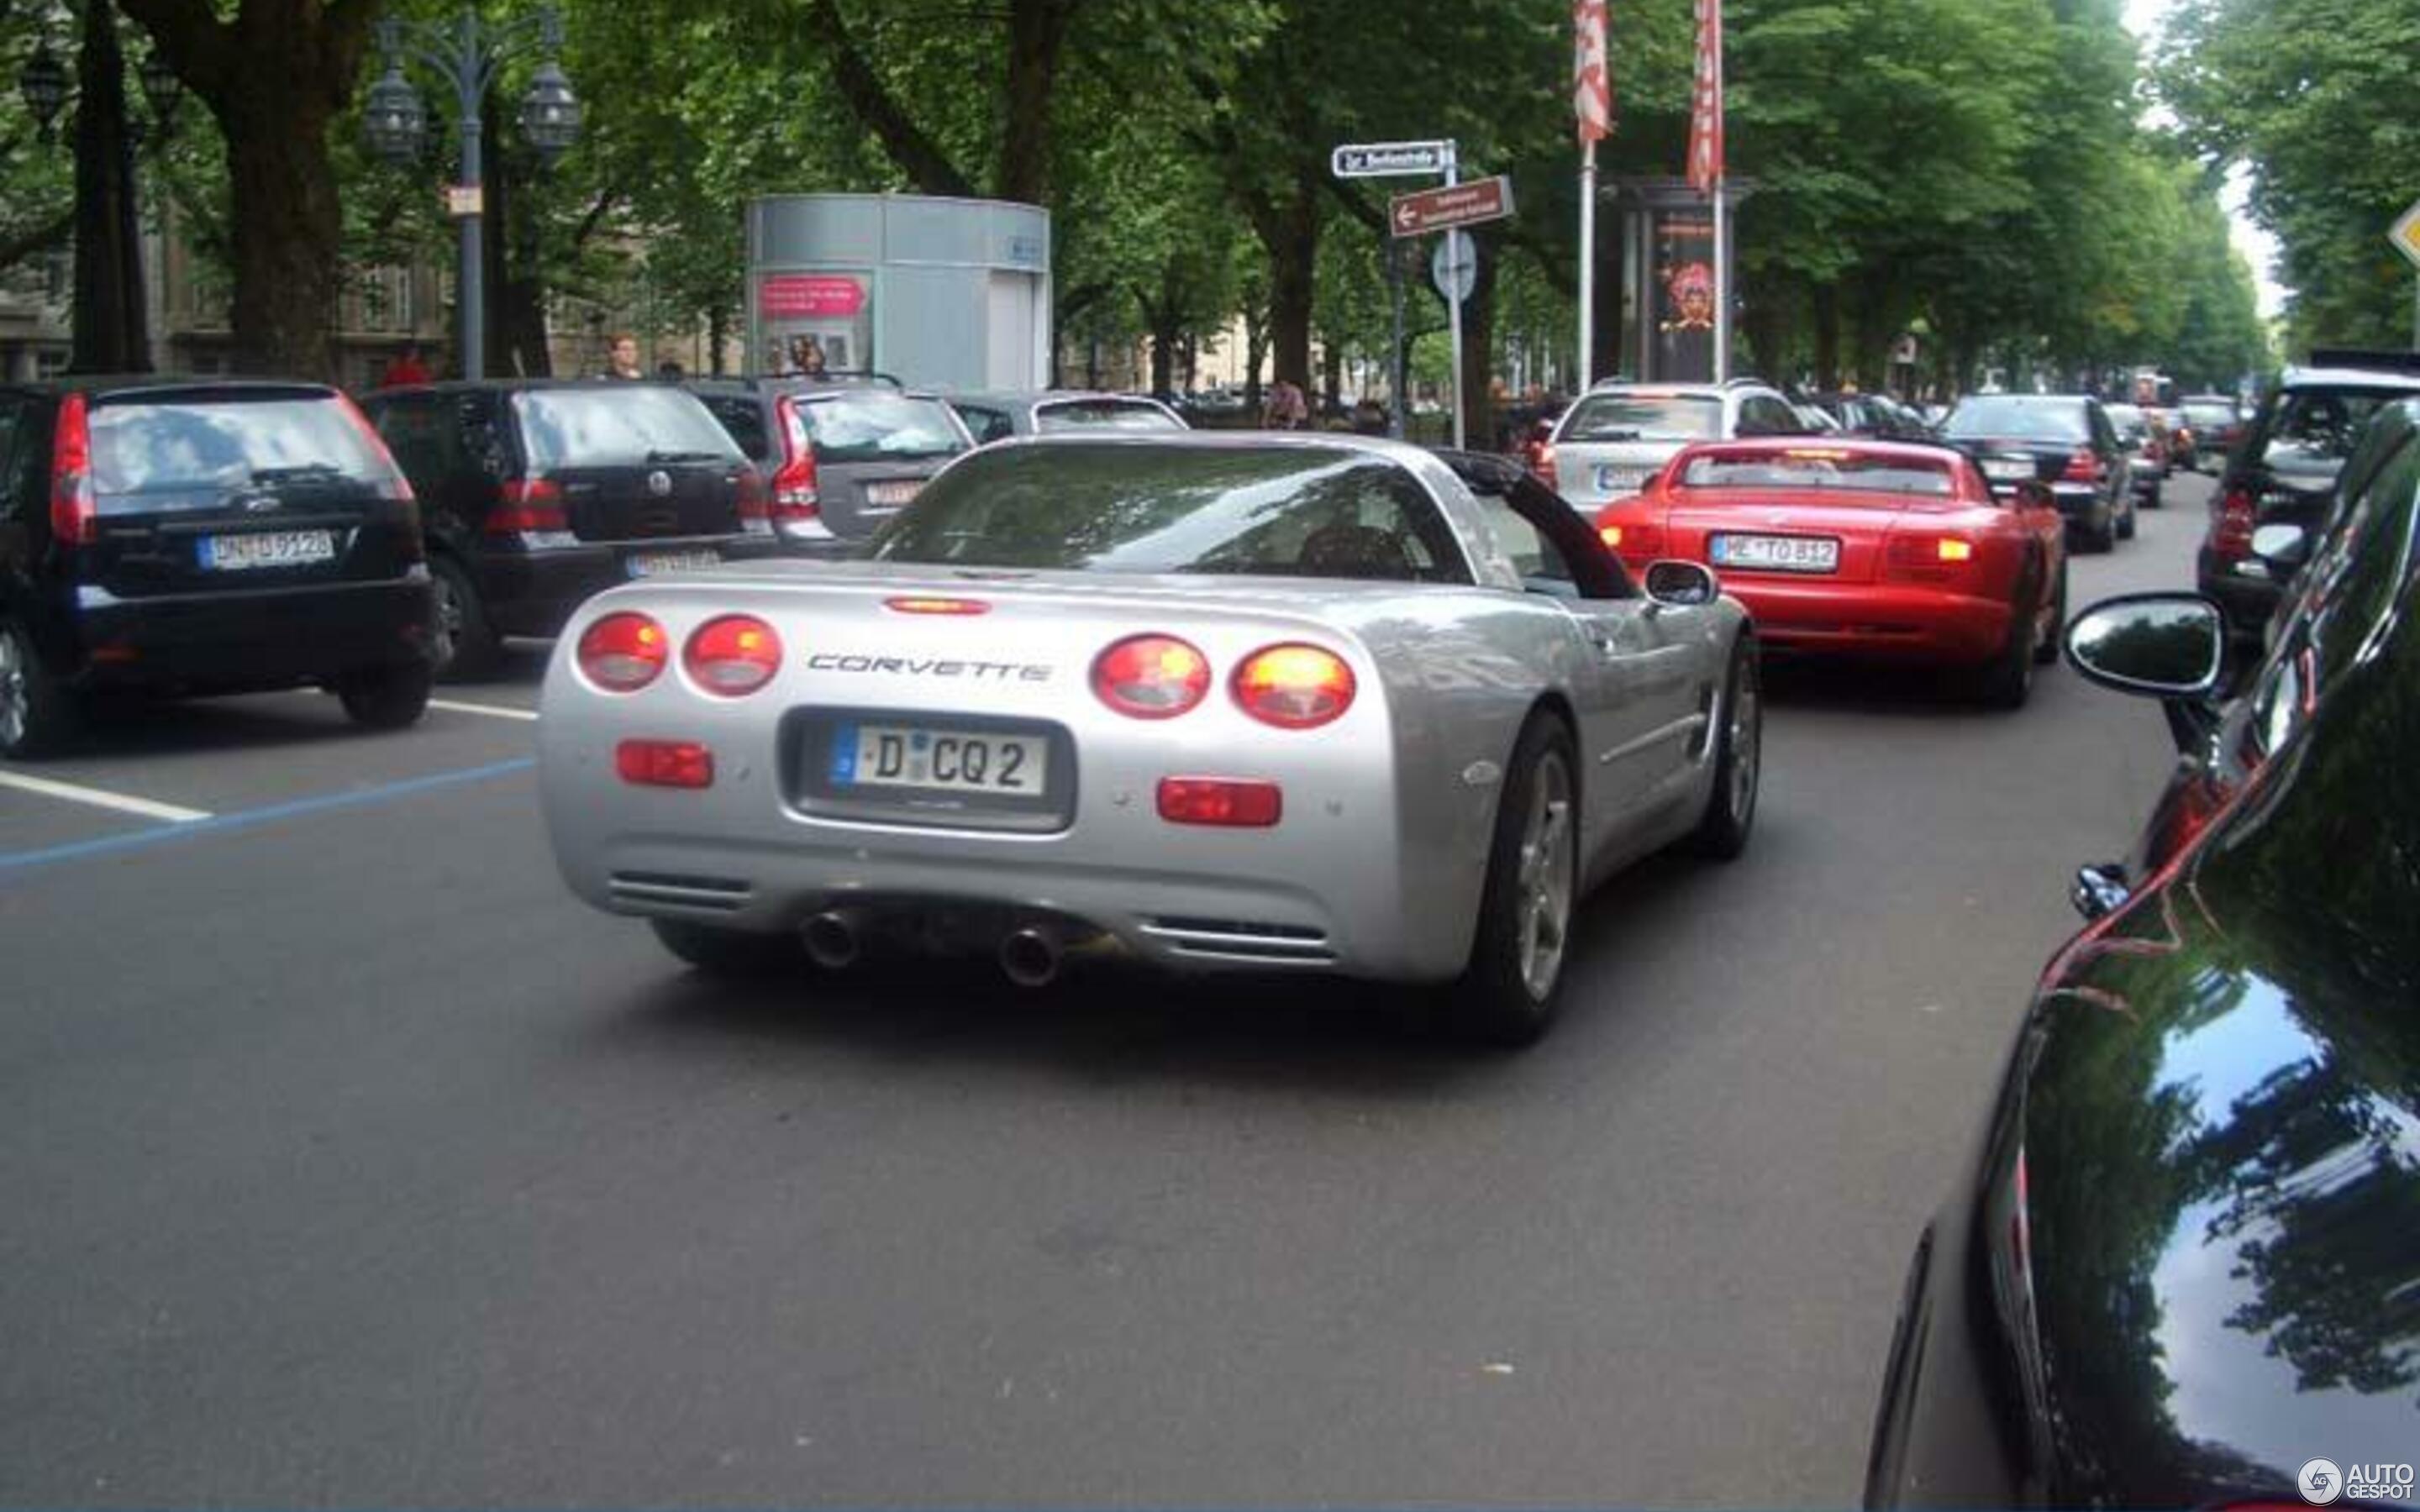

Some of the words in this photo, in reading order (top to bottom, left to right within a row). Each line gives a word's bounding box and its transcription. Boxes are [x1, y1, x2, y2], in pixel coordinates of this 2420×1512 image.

[808, 654, 1055, 681] CORVETTE
[876, 735, 903, 779] D
[997, 743, 1025, 787] 2
